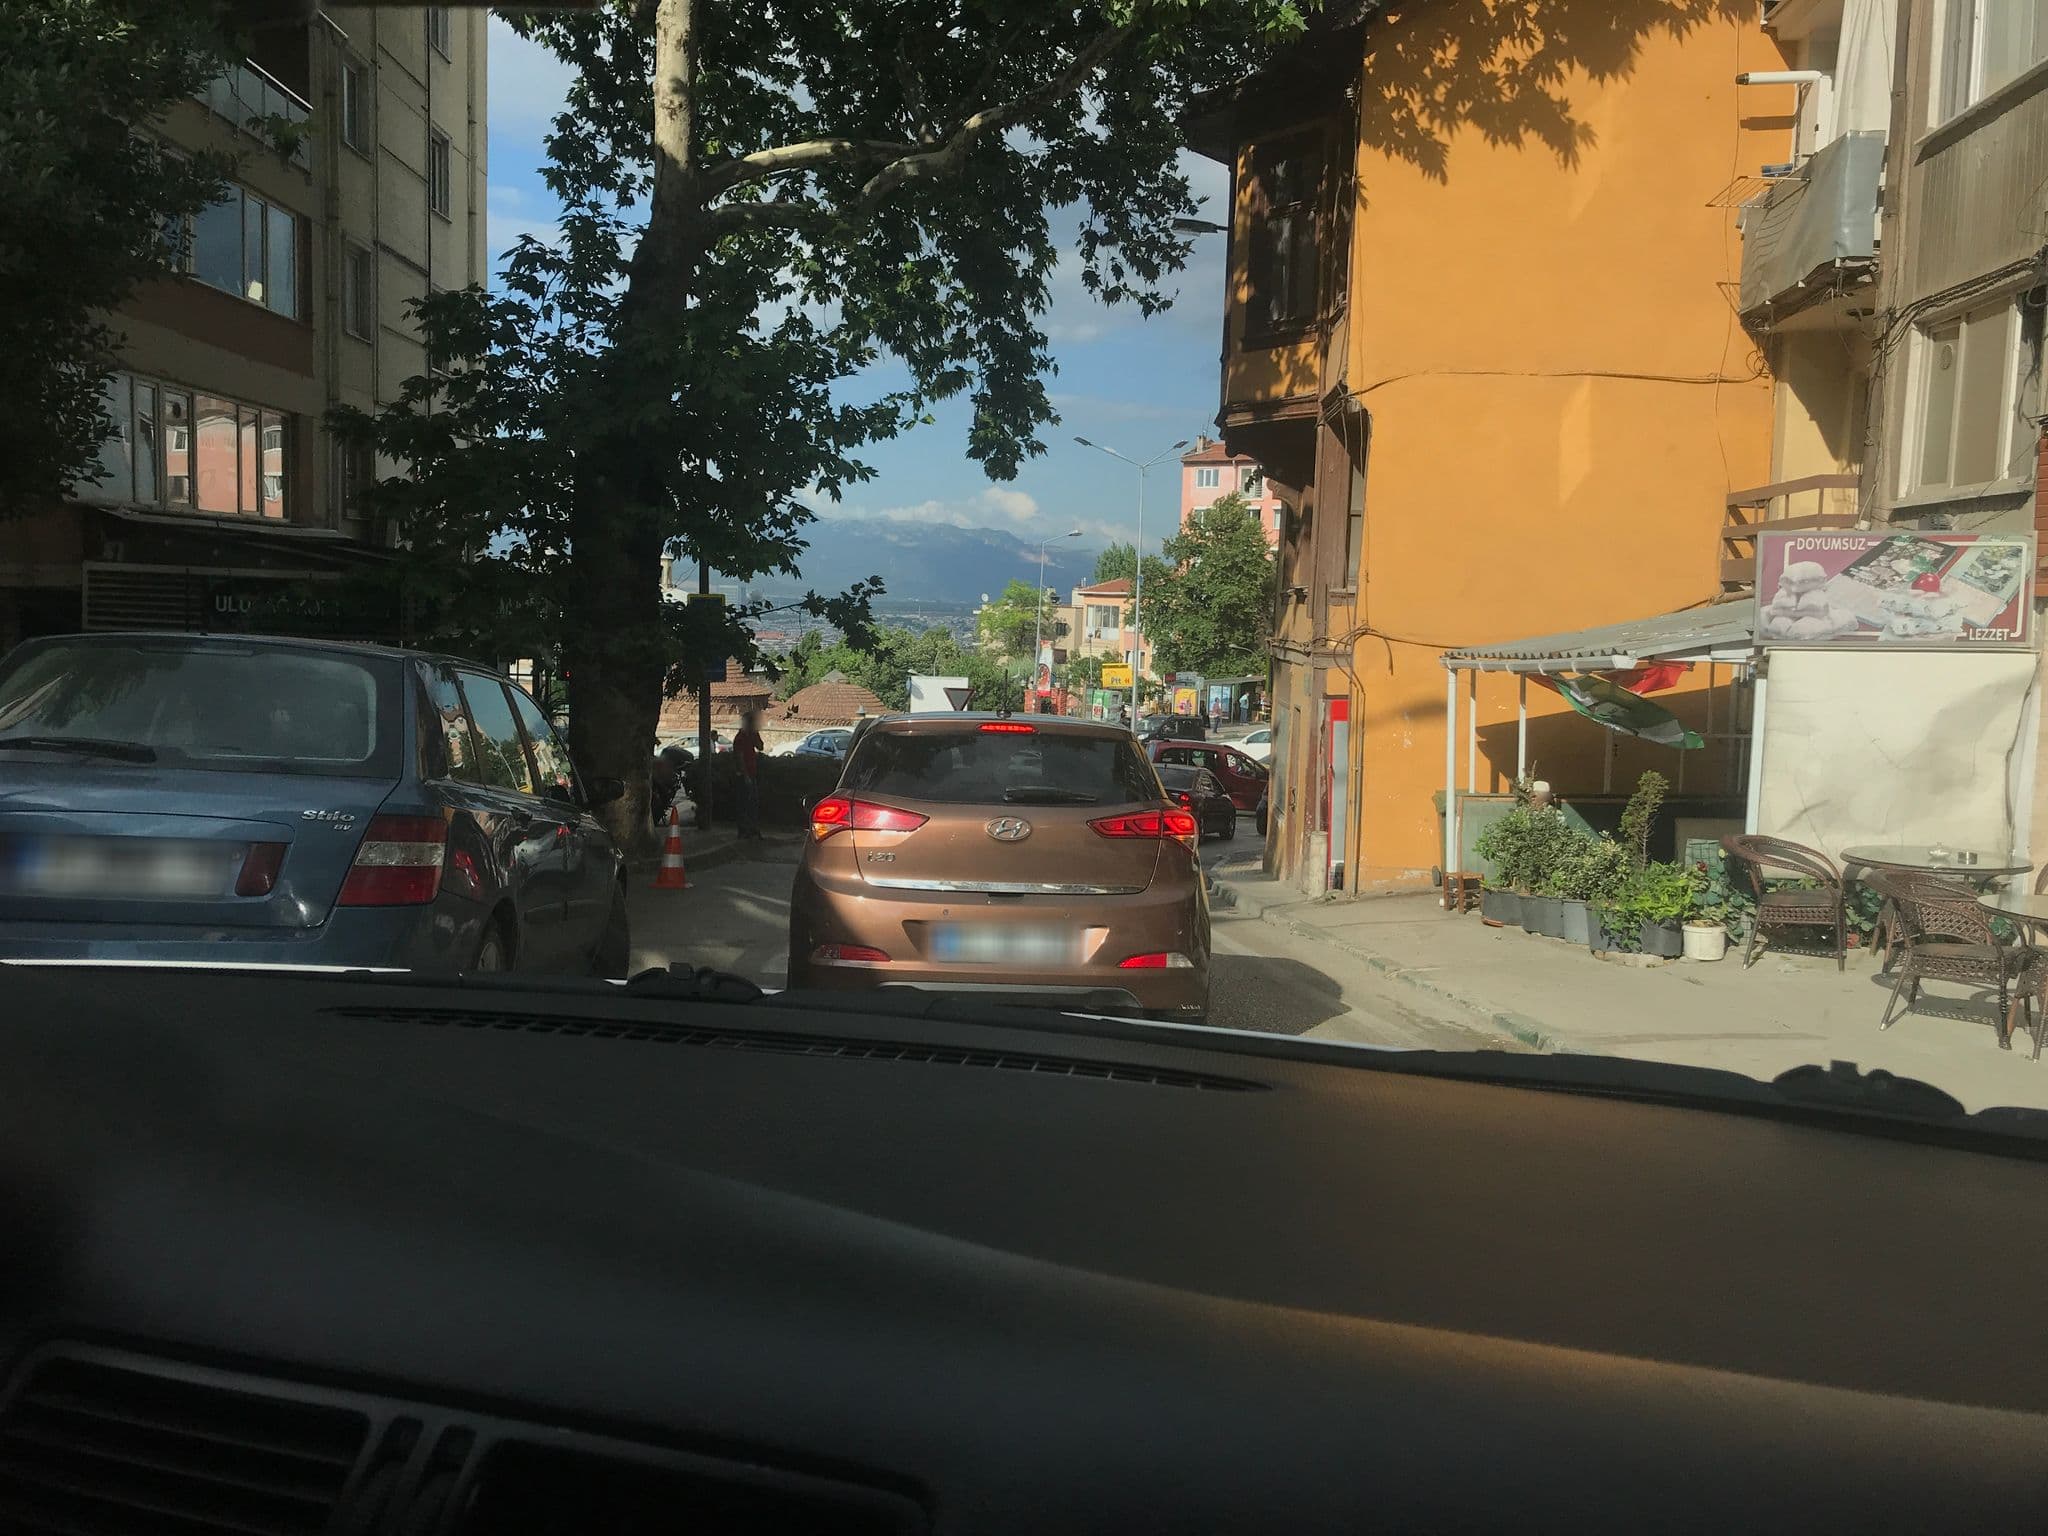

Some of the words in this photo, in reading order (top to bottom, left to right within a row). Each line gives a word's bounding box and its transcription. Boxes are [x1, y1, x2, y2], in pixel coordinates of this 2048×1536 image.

[1796, 537, 1866, 551] DOYUMSUZ
[1969, 628, 2010, 641] LEZZET
[301, 809, 355, 822] Stilo
